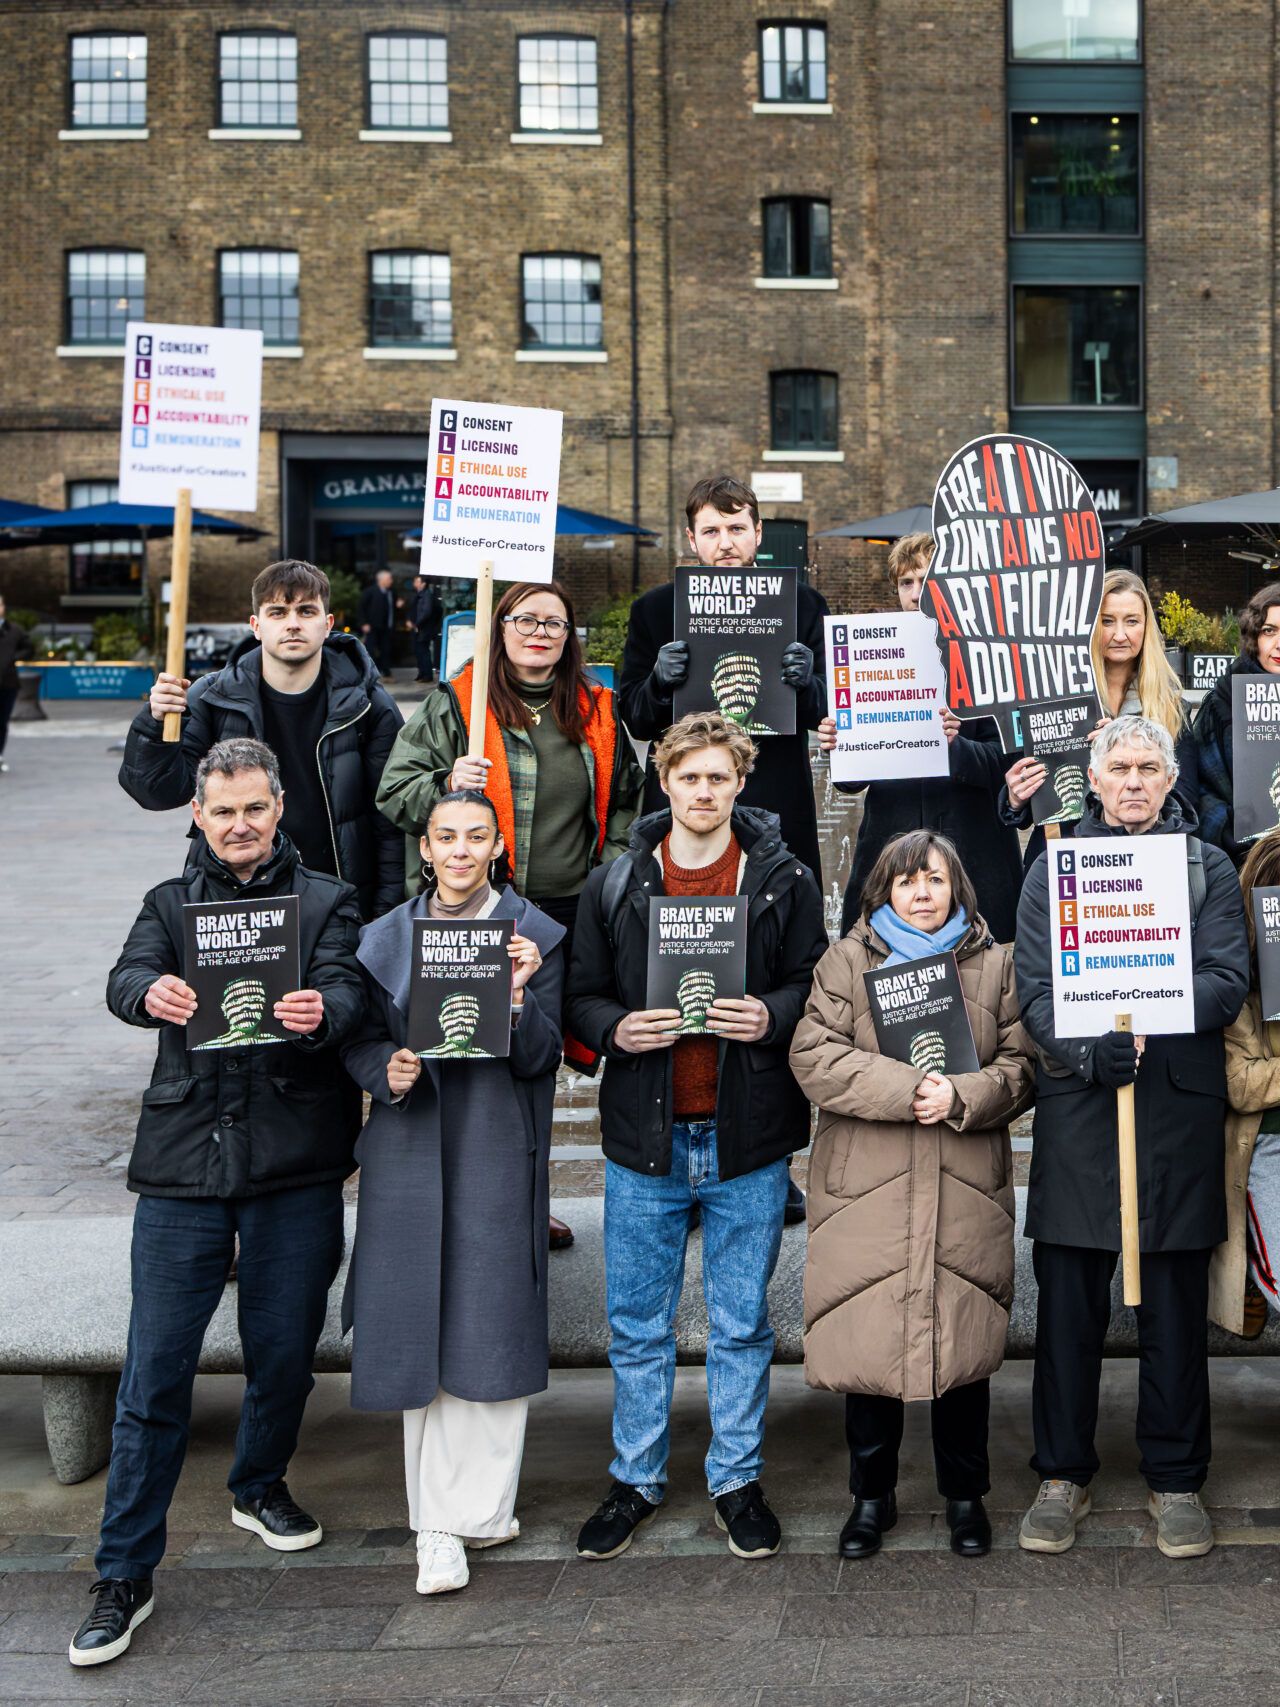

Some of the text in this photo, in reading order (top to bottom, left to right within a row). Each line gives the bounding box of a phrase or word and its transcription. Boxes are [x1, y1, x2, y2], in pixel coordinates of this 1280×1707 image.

[463, 417, 513, 432] CONSENT
[461, 439, 518, 455] LICENSING
[460, 461, 527, 478] ETHICAL USE
[939, 443, 1085, 519] CREATIVITY
[458, 483, 549, 502] ACCOUNTABILITY
[1091, 489, 1119, 511] AN
[457, 506, 541, 524] REMUNERATION
[431, 534, 545, 553] #JusticeForCreators
[934, 511, 1100, 575] CONTAINS NO
[689, 576, 783, 595] BRAVE NEW
[688, 595, 756, 614] WORLD?
[928, 565, 1096, 638] ARTIFICIAL
[853, 627, 897, 639] CONSENT
[854, 648, 905, 661] LICENSING
[855, 668, 915, 681] ETHICAL USE
[950, 640, 1094, 709] ADDITIVES
[1194, 657, 1235, 677] CAR
[1194, 678, 1218, 688] KING
[856, 688, 937, 702] ACCOUNTABILITY
[857, 710, 932, 724] REMUNERATION
[1029, 707, 1087, 728] BRAVE NEW
[1030, 723, 1074, 742] WORLD?
[838, 739, 940, 751] #JusticeForCreators
[1081, 854, 1133, 868] CONSENT
[1083, 879, 1142, 893] LICENSING
[659, 907, 736, 922] BRAVE NEW
[1084, 903, 1155, 918] ETHICAL USE
[195, 910, 285, 932] BRAVE NEW
[422, 930, 503, 946] BRAVE NEW
[659, 923, 714, 938] WORLD?
[1085, 927, 1180, 943] ACCOUNTABILITY
[195, 929, 260, 949] WORLD?
[421, 947, 479, 962] WORLD?
[1086, 954, 1174, 969] REMUNERATION
[874, 963, 946, 995] BRAVE NEW
[877, 984, 930, 1011] WORLD?
[1063, 988, 1184, 1002] #JusticeForCreators
